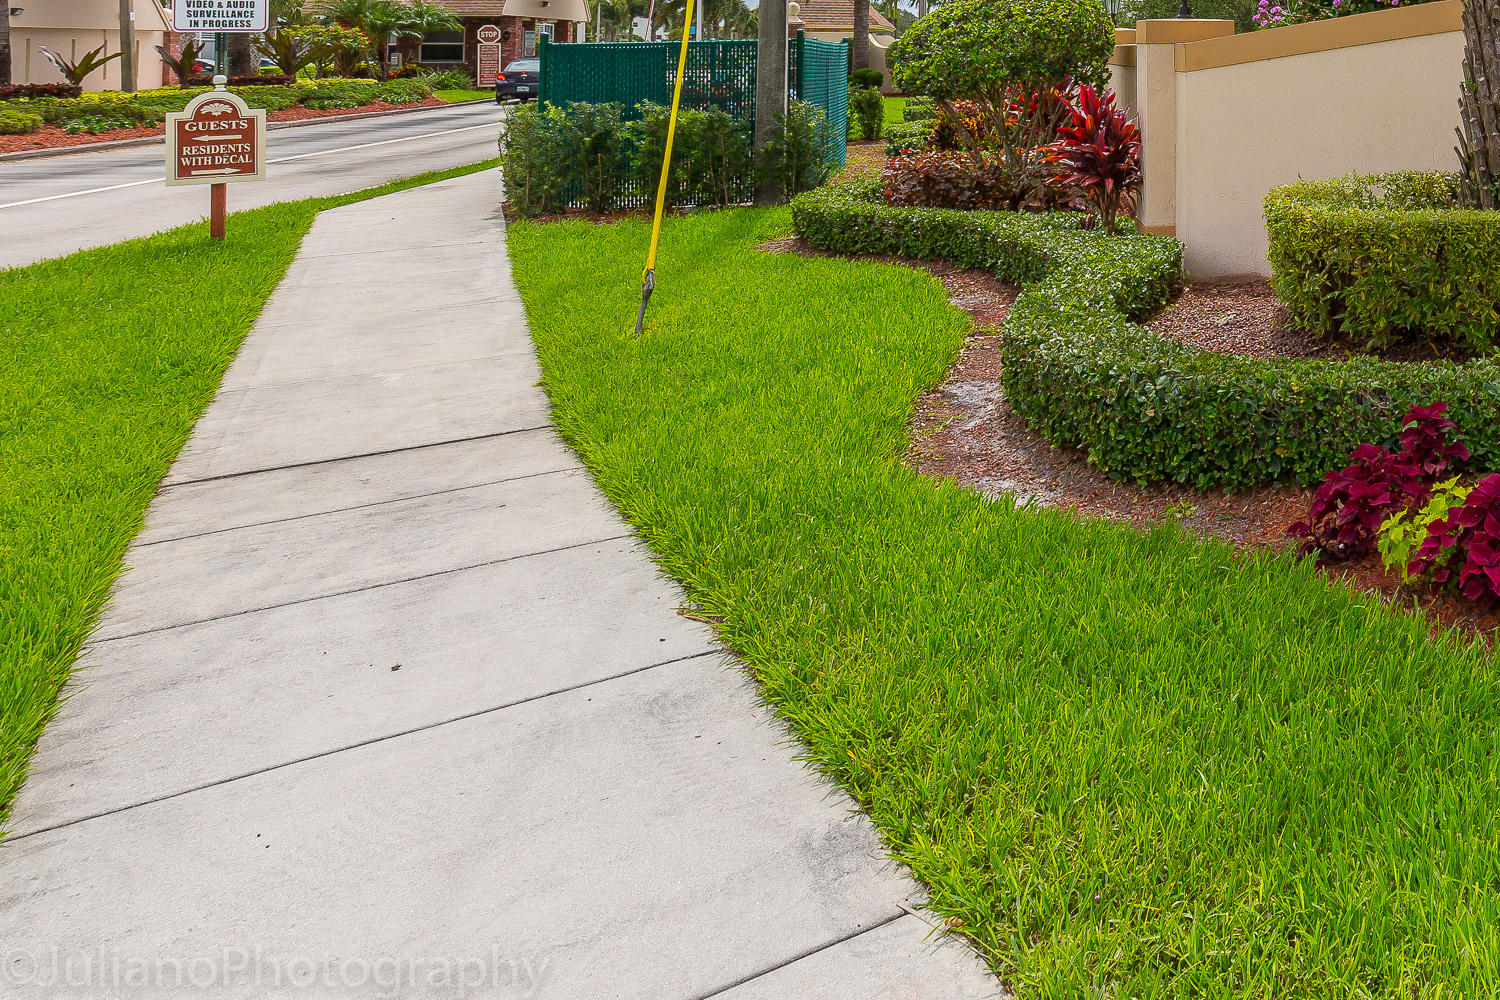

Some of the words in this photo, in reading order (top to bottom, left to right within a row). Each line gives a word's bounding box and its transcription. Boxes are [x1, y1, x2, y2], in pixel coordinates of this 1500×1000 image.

[186, 0, 214, 9] VIDEO
[217, 1, 223, 9] &
[226, 0, 255, 9] AUDIO
[186, 10, 255, 18] SURVEILLANCE
[189, 20, 199, 28] IN
[202, 20, 252, 28] PROGRESS
[184, 120, 248, 132] GUESTS
[182, 143, 251, 156] RESIDENTS
[180, 156, 212, 166] WITH
[214, 154, 253, 165] DECAL
